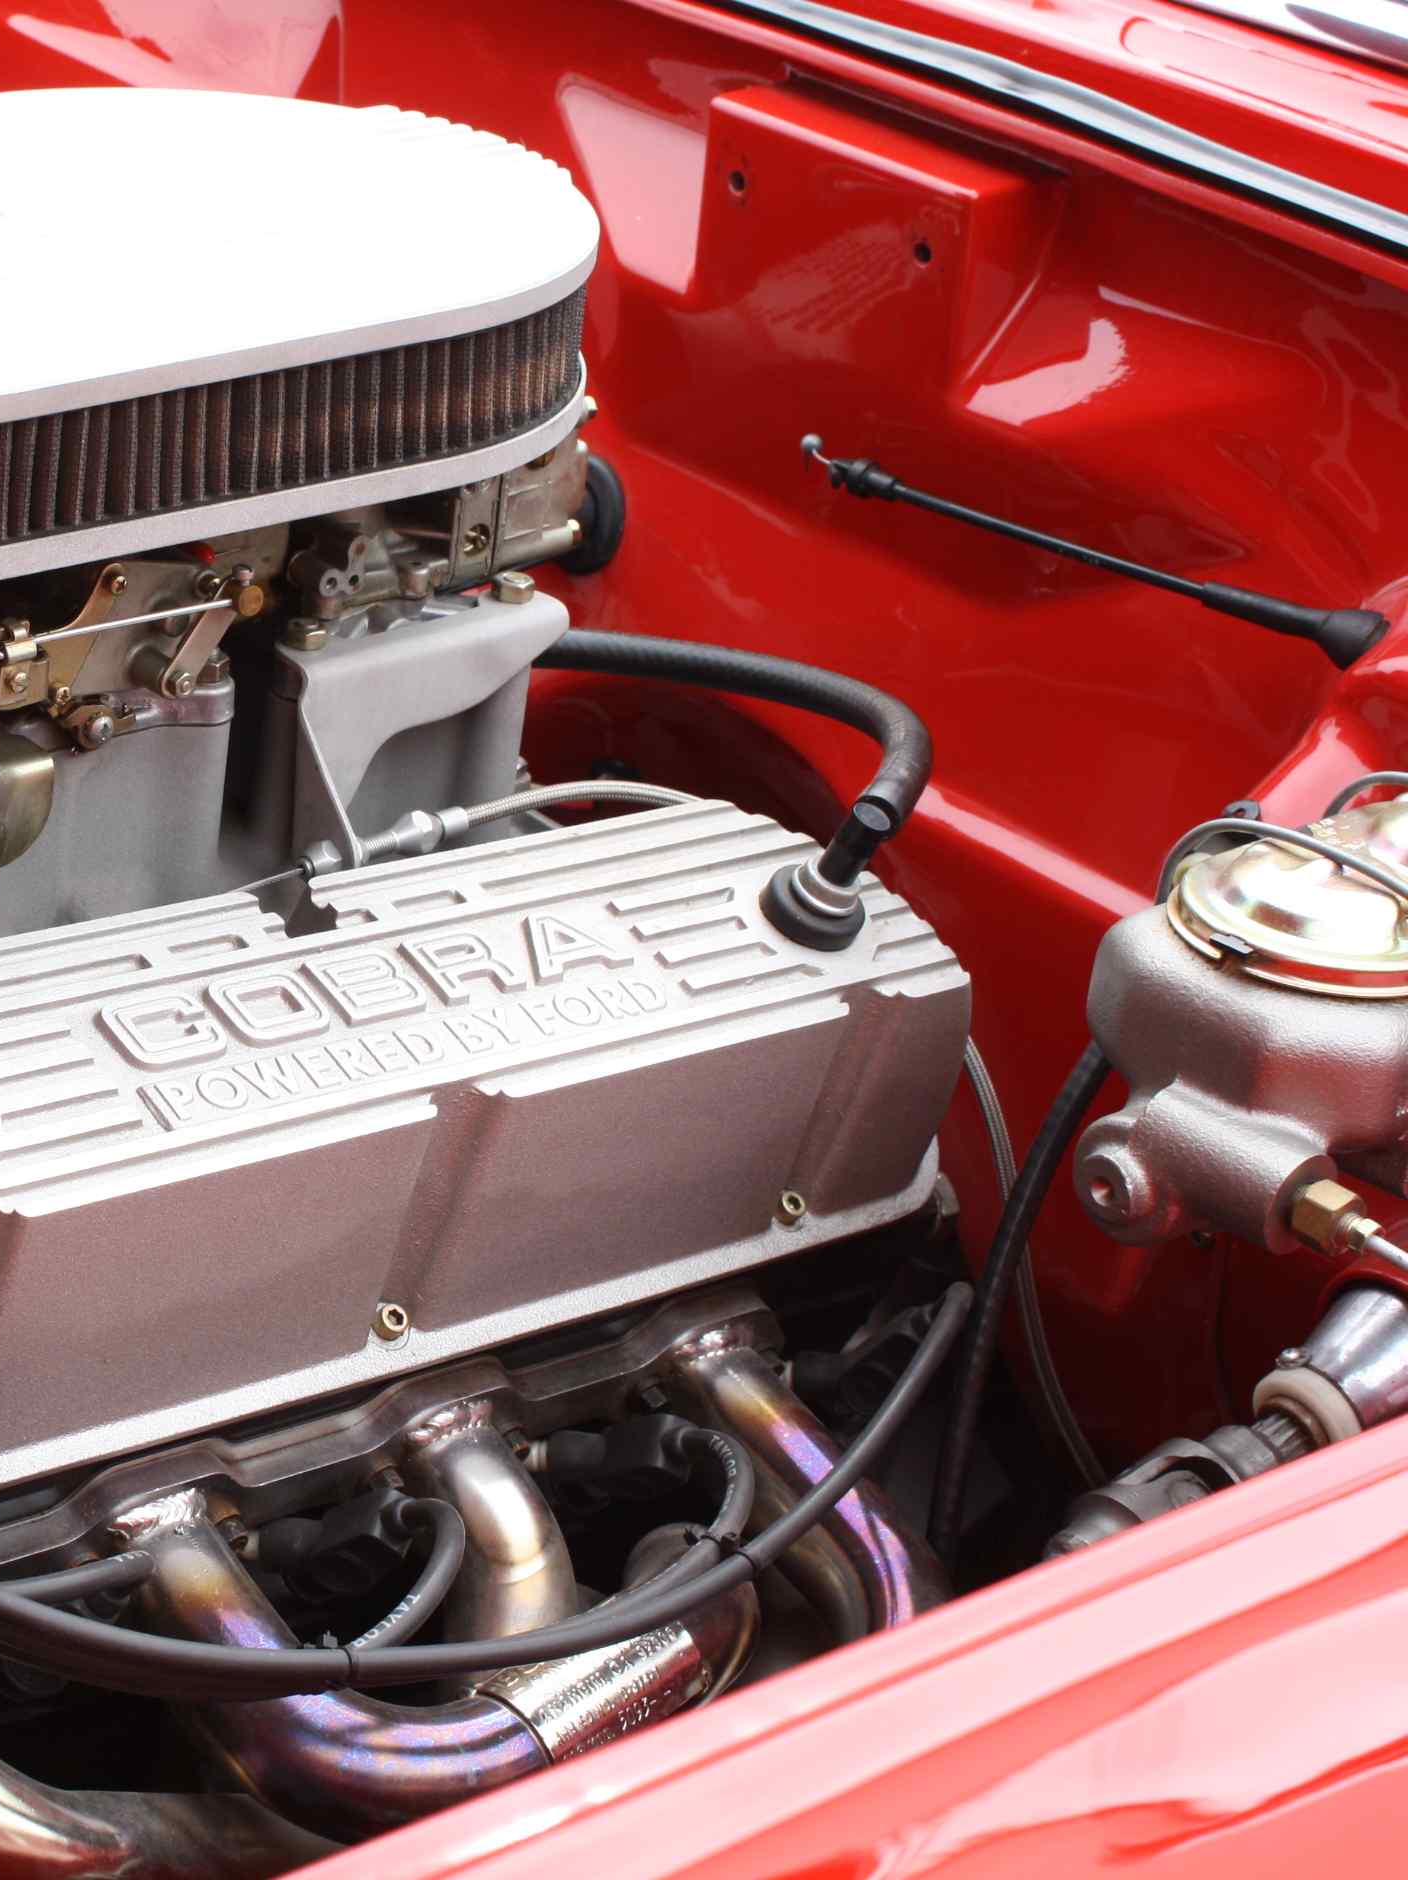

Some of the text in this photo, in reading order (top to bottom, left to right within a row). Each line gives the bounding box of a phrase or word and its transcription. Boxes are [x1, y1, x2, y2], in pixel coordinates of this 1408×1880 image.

[94, 912, 634, 1073] COBRA
[152, 978, 668, 1121] POWERED BY FORD
[352, 1593, 421, 1648] TAYLOR
